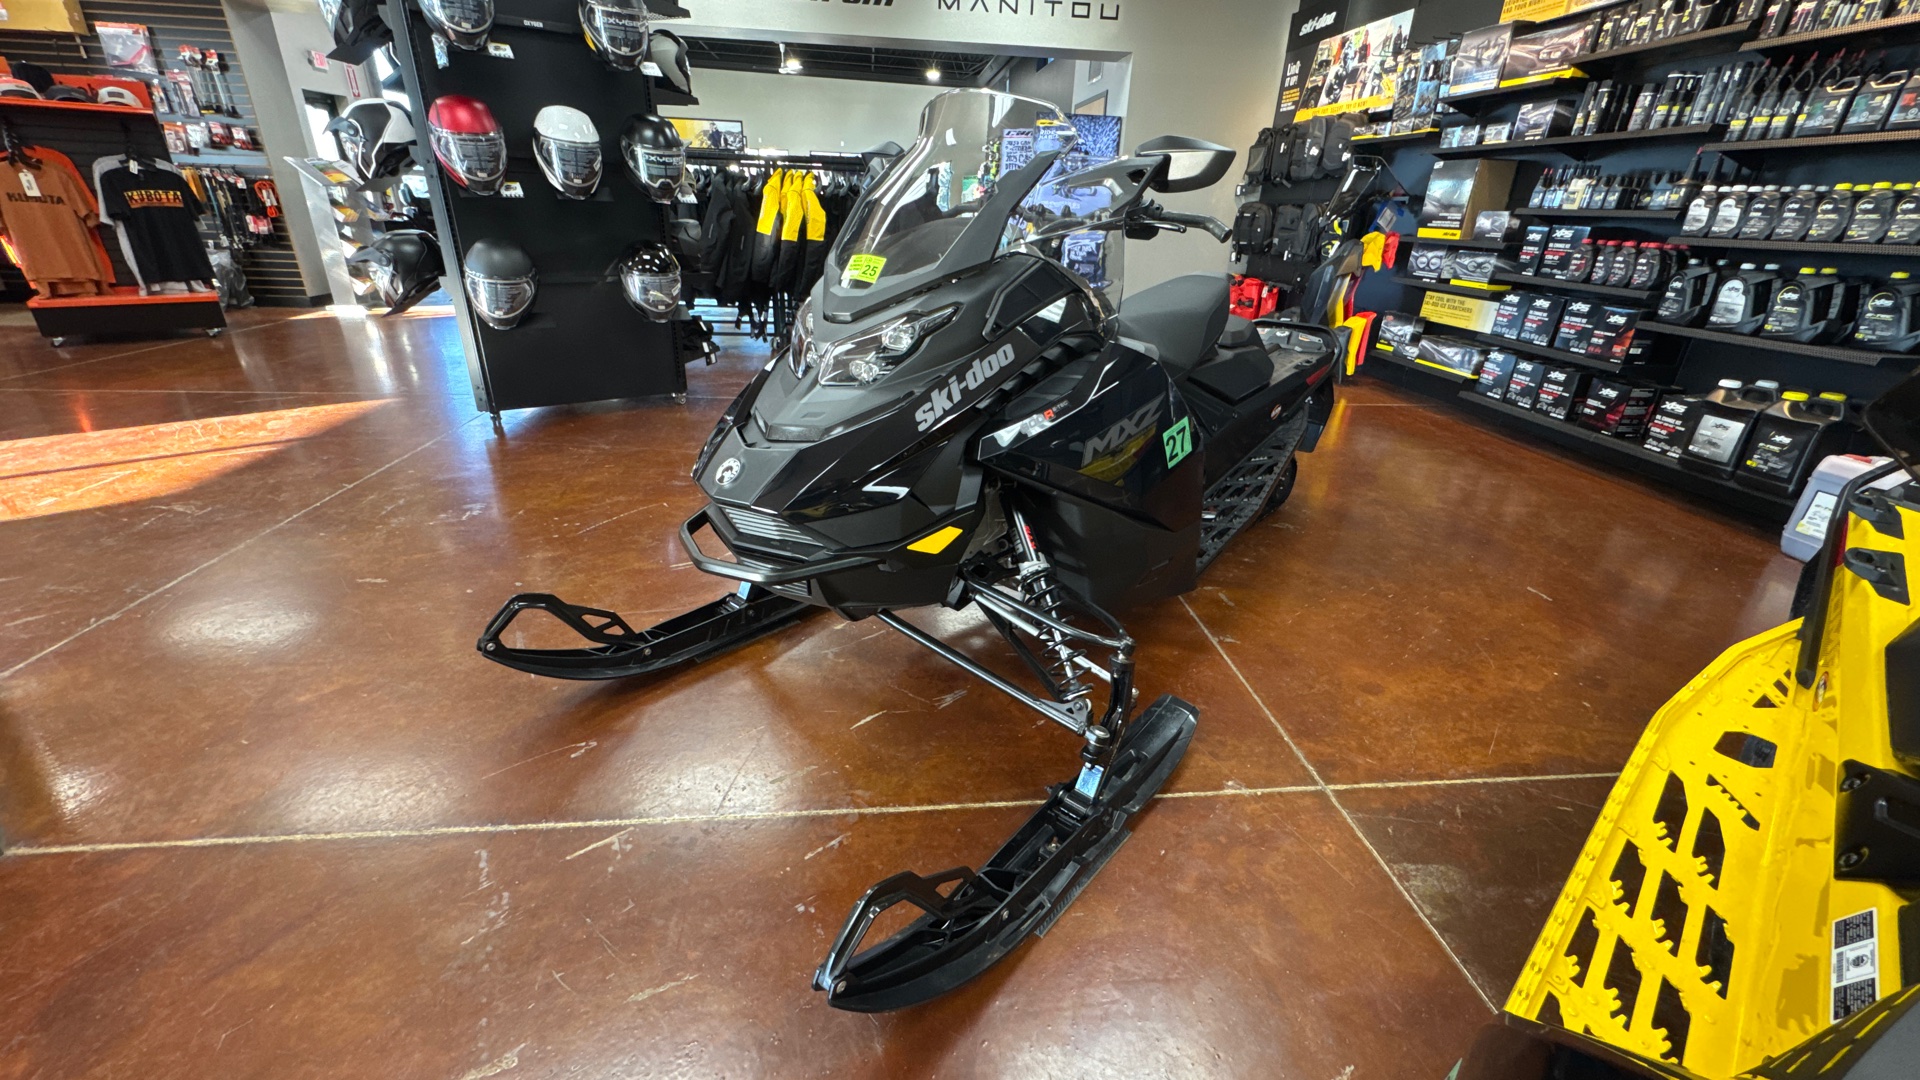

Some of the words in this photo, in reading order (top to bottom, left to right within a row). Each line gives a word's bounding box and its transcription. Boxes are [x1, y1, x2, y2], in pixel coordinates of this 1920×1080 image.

[937, 0, 1120, 20] MANITOU
[523, 19, 544, 28] OXYGEN
[601, 16, 641, 28] OXYGE
[1299, 11, 1337, 36] ski-doo
[127, 190, 182, 204] KUBOTA
[1552, 228, 1574, 238] XPS
[862, 264, 878, 277] 25
[1503, 294, 1520, 303] XPS
[1532, 299, 1551, 308] XPS
[1568, 302, 1591, 312] XPS
[1606, 315, 1627, 324] XPS
[1487, 352, 1505, 362] XPS
[1517, 362, 1533, 371] XPS
[1547, 371, 1567, 381] XPS
[915, 343, 1015, 432] ski-doo
[1598, 388, 1619, 398] XPS
[1660, 401, 1688, 413] XPS
[1081, 392, 1166, 468] MXZ
[1166, 424, 1186, 463] 27
